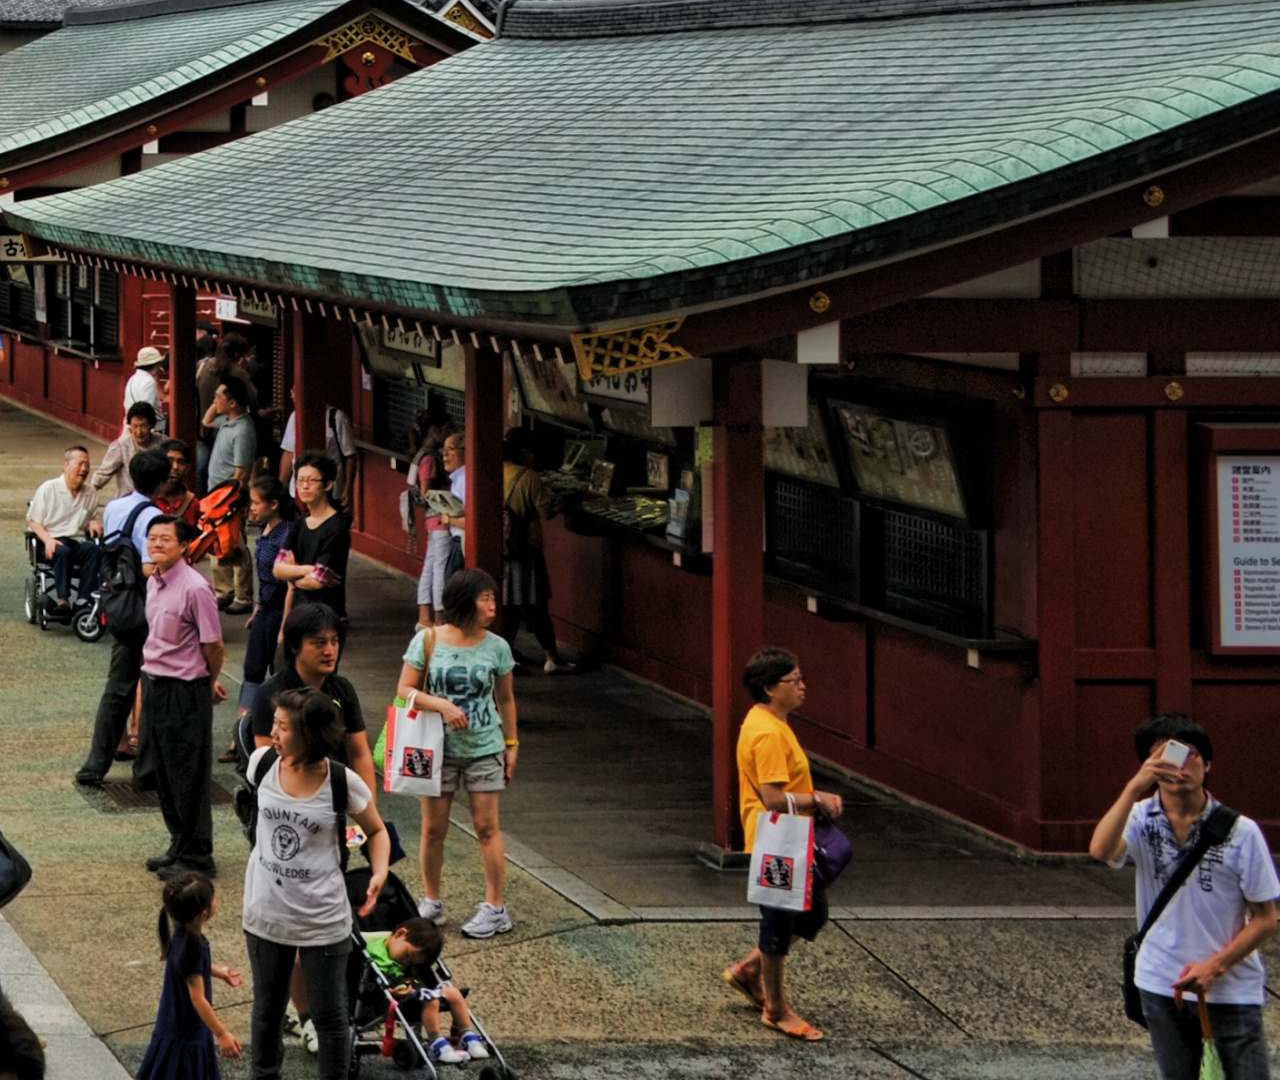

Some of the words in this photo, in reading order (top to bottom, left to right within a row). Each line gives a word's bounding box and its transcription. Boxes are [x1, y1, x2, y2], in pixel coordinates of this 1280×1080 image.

[1233, 557, 1258, 566] Guide
[1260, 557, 1269, 566] to
[264, 807, 324, 836] OUNTAIN
